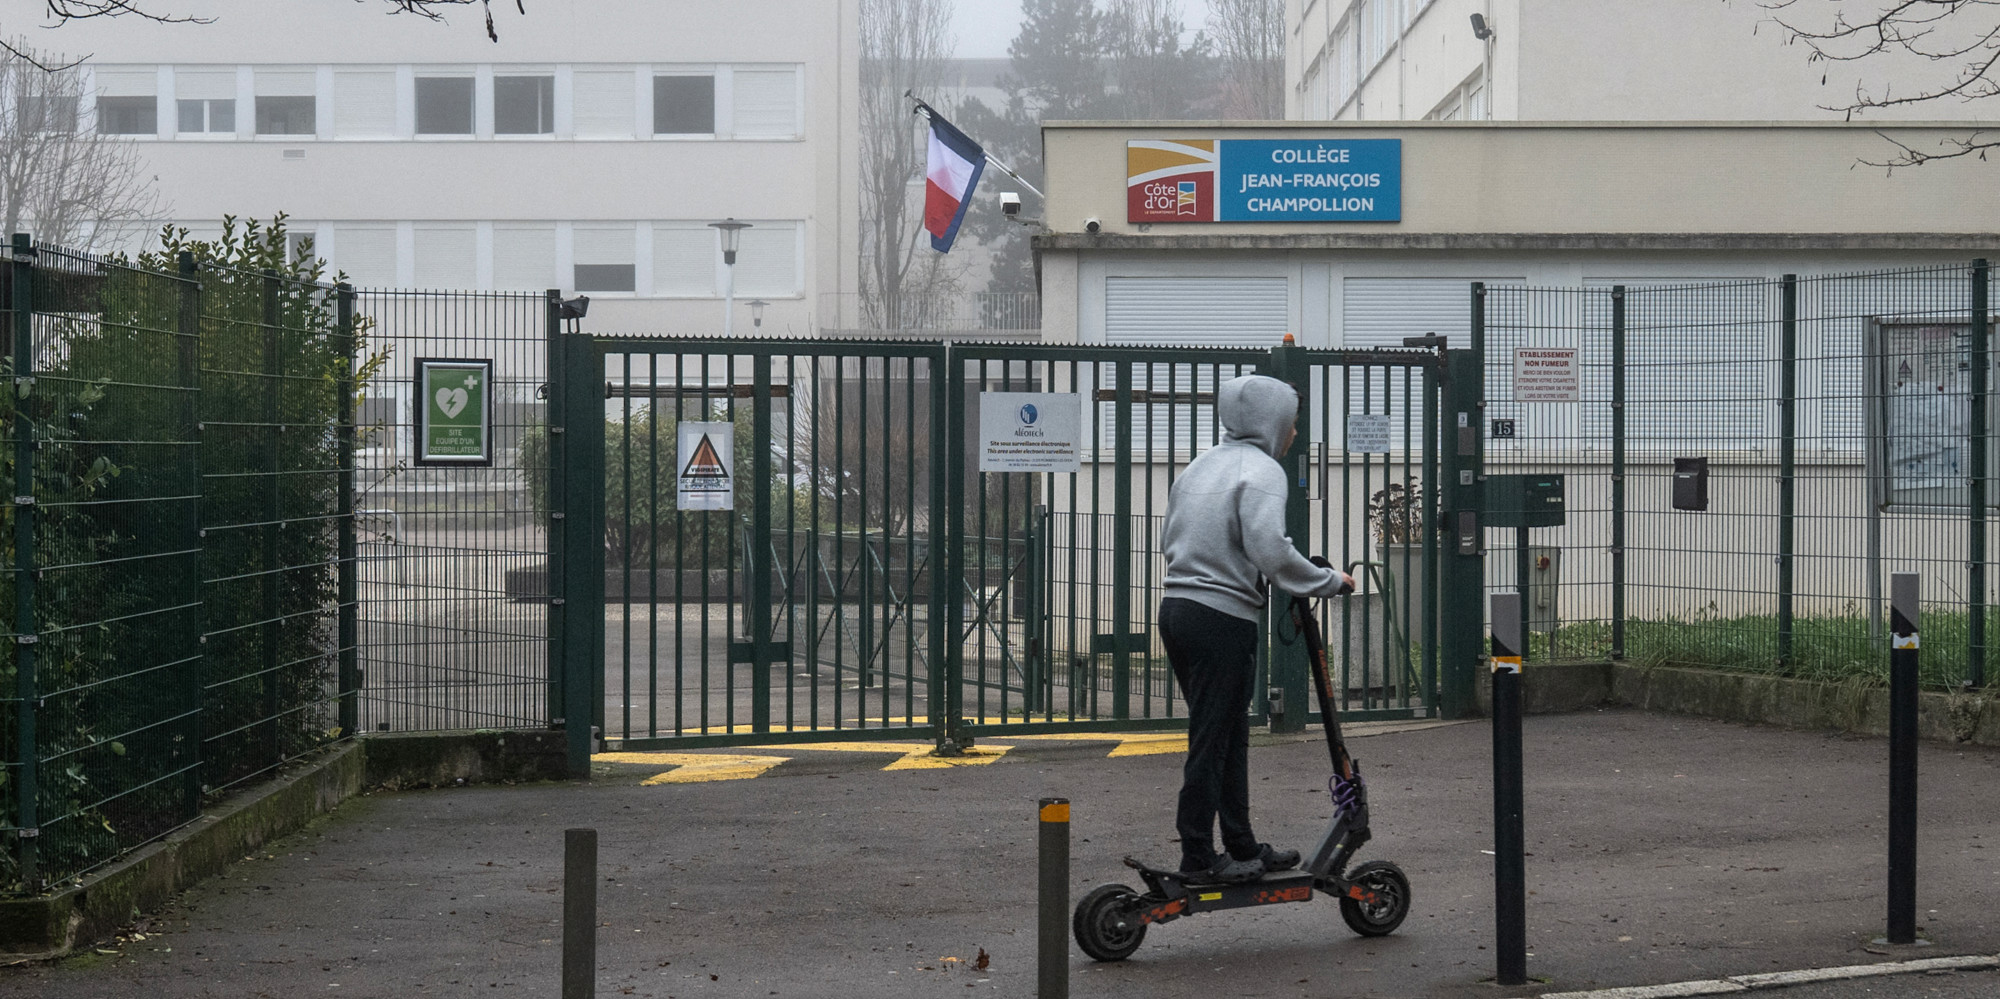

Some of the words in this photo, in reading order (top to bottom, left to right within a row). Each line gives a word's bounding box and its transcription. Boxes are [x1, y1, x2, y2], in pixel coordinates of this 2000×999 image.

[1271, 144, 1350, 164] COLLÈGE
[1144, 183, 1176, 196] Côte
[1240, 173, 1381, 193] JEAN-FRANÇOIS
[1144, 195, 1176, 209] d'Or
[1247, 197, 1374, 212] CHAMPOLLION
[1497, 421, 1511, 435] 15
